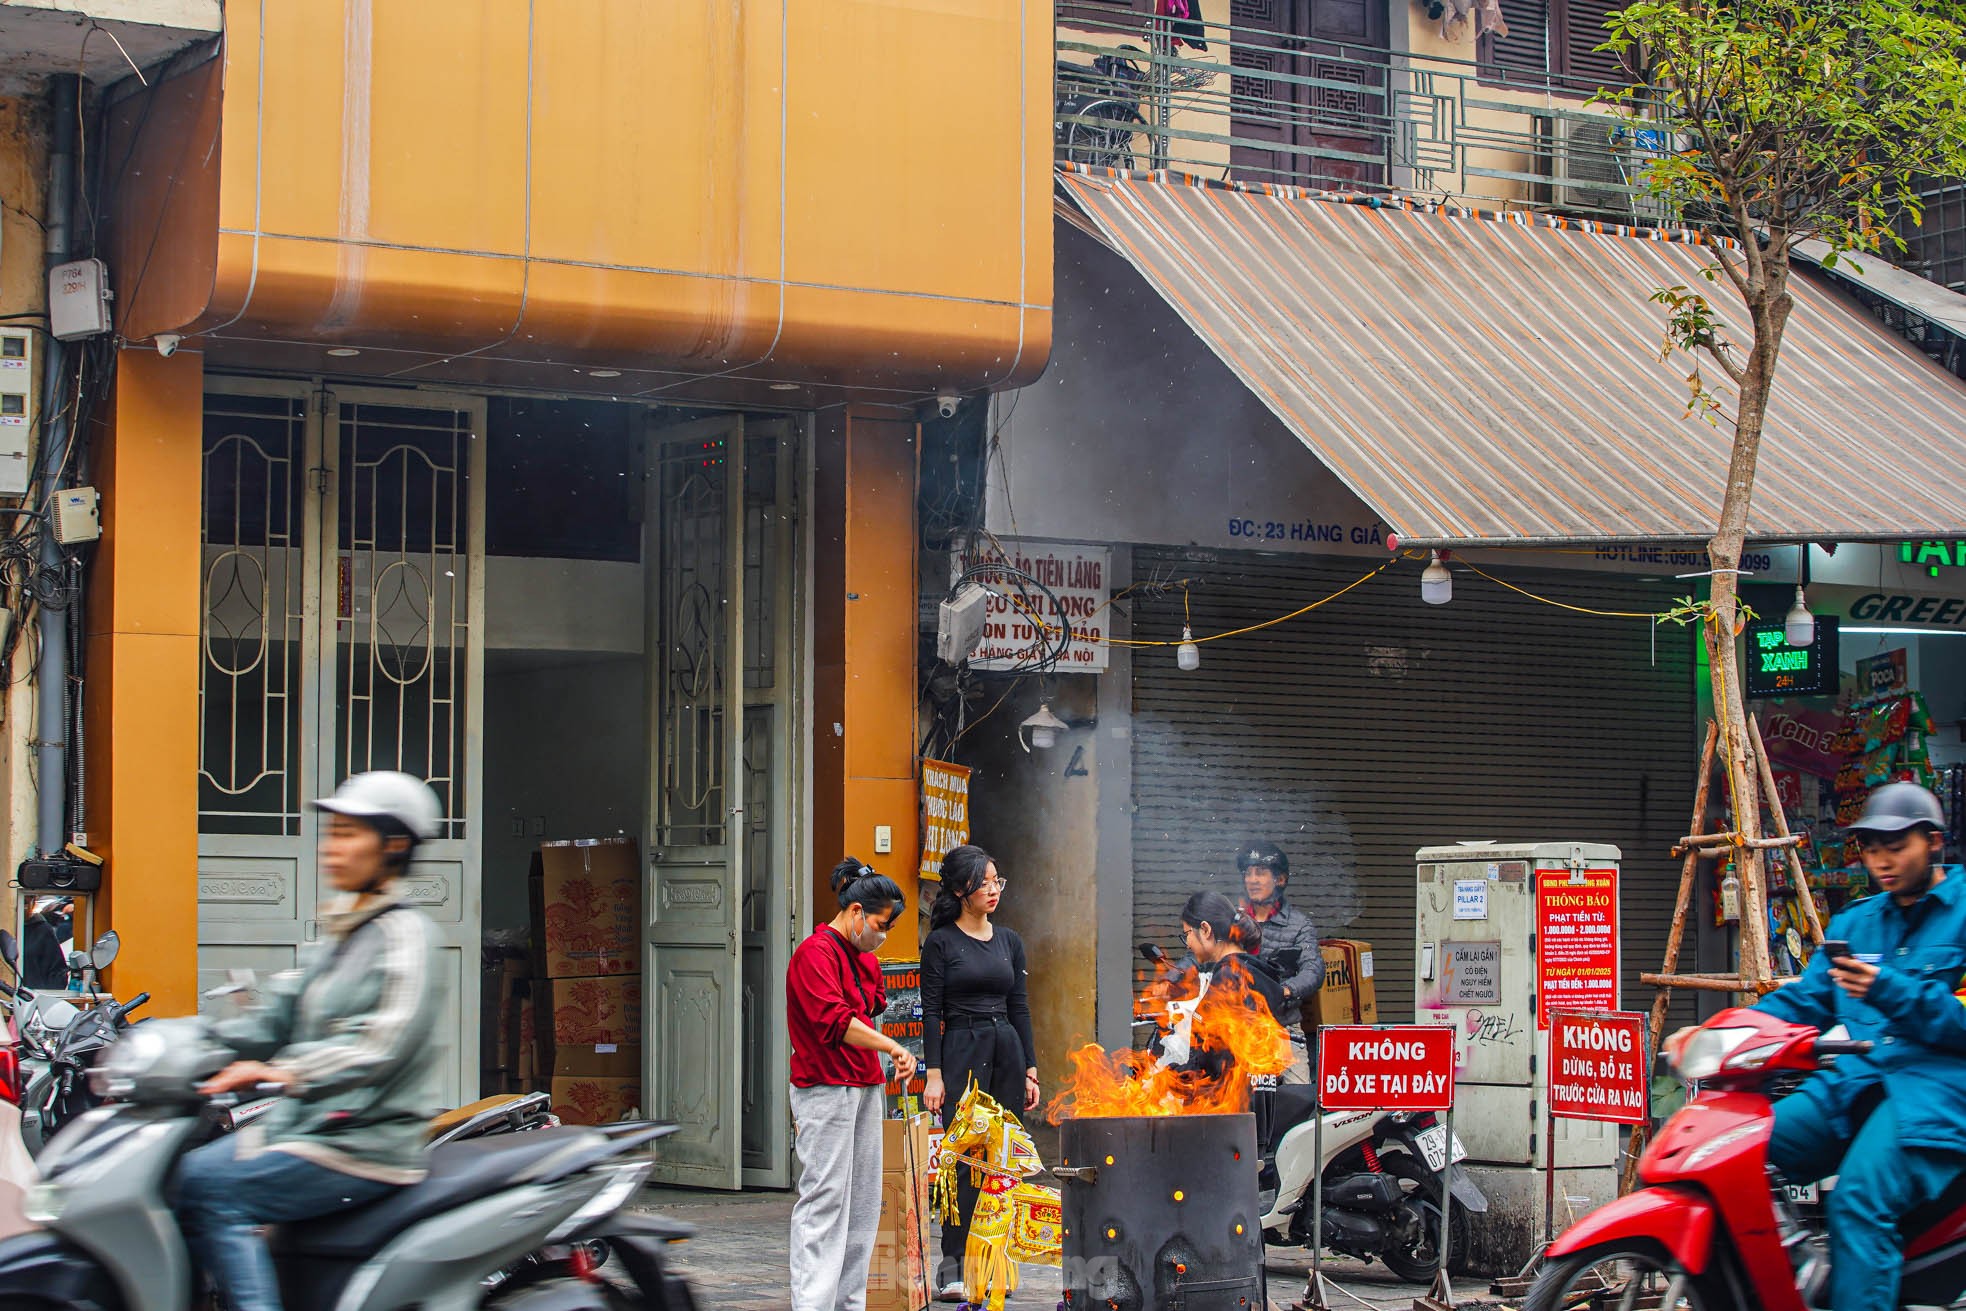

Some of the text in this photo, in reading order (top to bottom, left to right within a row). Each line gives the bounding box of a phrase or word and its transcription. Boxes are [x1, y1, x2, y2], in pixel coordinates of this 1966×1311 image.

[1265, 522, 1285, 539] 23
[1290, 520, 1343, 542] HÀNG
[1351, 521, 1382, 545] GIẤ
[1068, 556, 1101, 590] LÃNG
[1073, 650, 1094, 666] NỘI
[1761, 651, 1809, 672] XANH
[1775, 675, 1794, 688] 24H
[1871, 669, 1896, 687] POCA
[1766, 713, 1818, 749] Kem
[926, 768, 968, 794] KHÁCH MUA
[926, 825, 938, 852] HI
[1545, 892, 1609, 906] THÔNG BÁO
[1549, 913, 1570, 923] PHẠT
[1326, 960, 1350, 986] ink
[1546, 967, 1611, 976] TỪ NGÀY 01/01/2025
[1348, 1038, 1426, 1060] KHÔNG
[1563, 1022, 1632, 1052] KHÔNG
[1563, 1055, 1633, 1081] DỪNG, ĐỖ XE
[1326, 1066, 1447, 1099] ĐỖ XE TẠI ĐÂY
[1553, 1082, 1642, 1107] TRƯỚC CỬA RA VÀO
[1332, 1110, 1374, 1128] VISION
